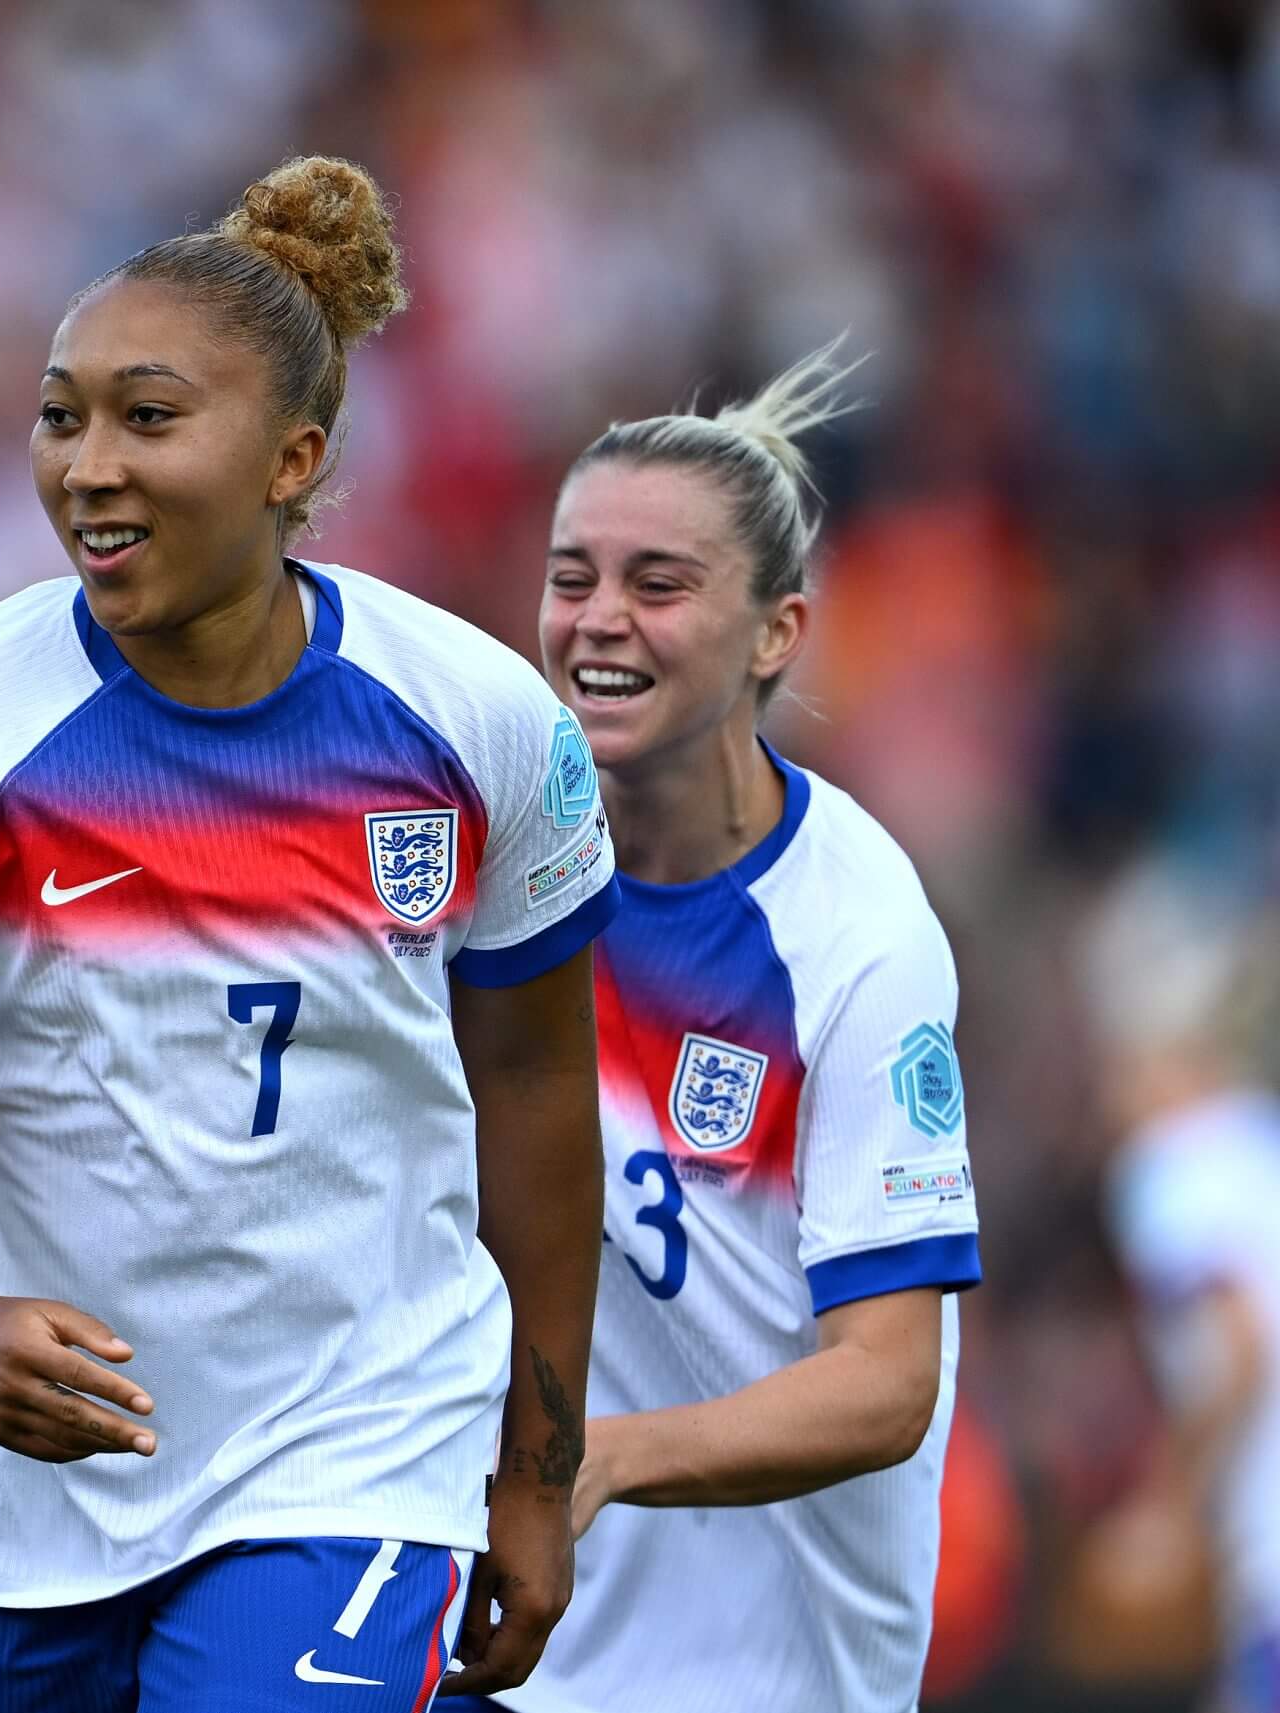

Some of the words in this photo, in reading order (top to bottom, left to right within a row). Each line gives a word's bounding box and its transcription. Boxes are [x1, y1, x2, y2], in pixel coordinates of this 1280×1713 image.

[528, 836, 598, 896] FOUNDATION
[410, 945, 432, 957] 2025
[227, 981, 301, 1138] 7
[884, 1175, 962, 1195] FOUNDATION
[604, 1149, 688, 1300] 3
